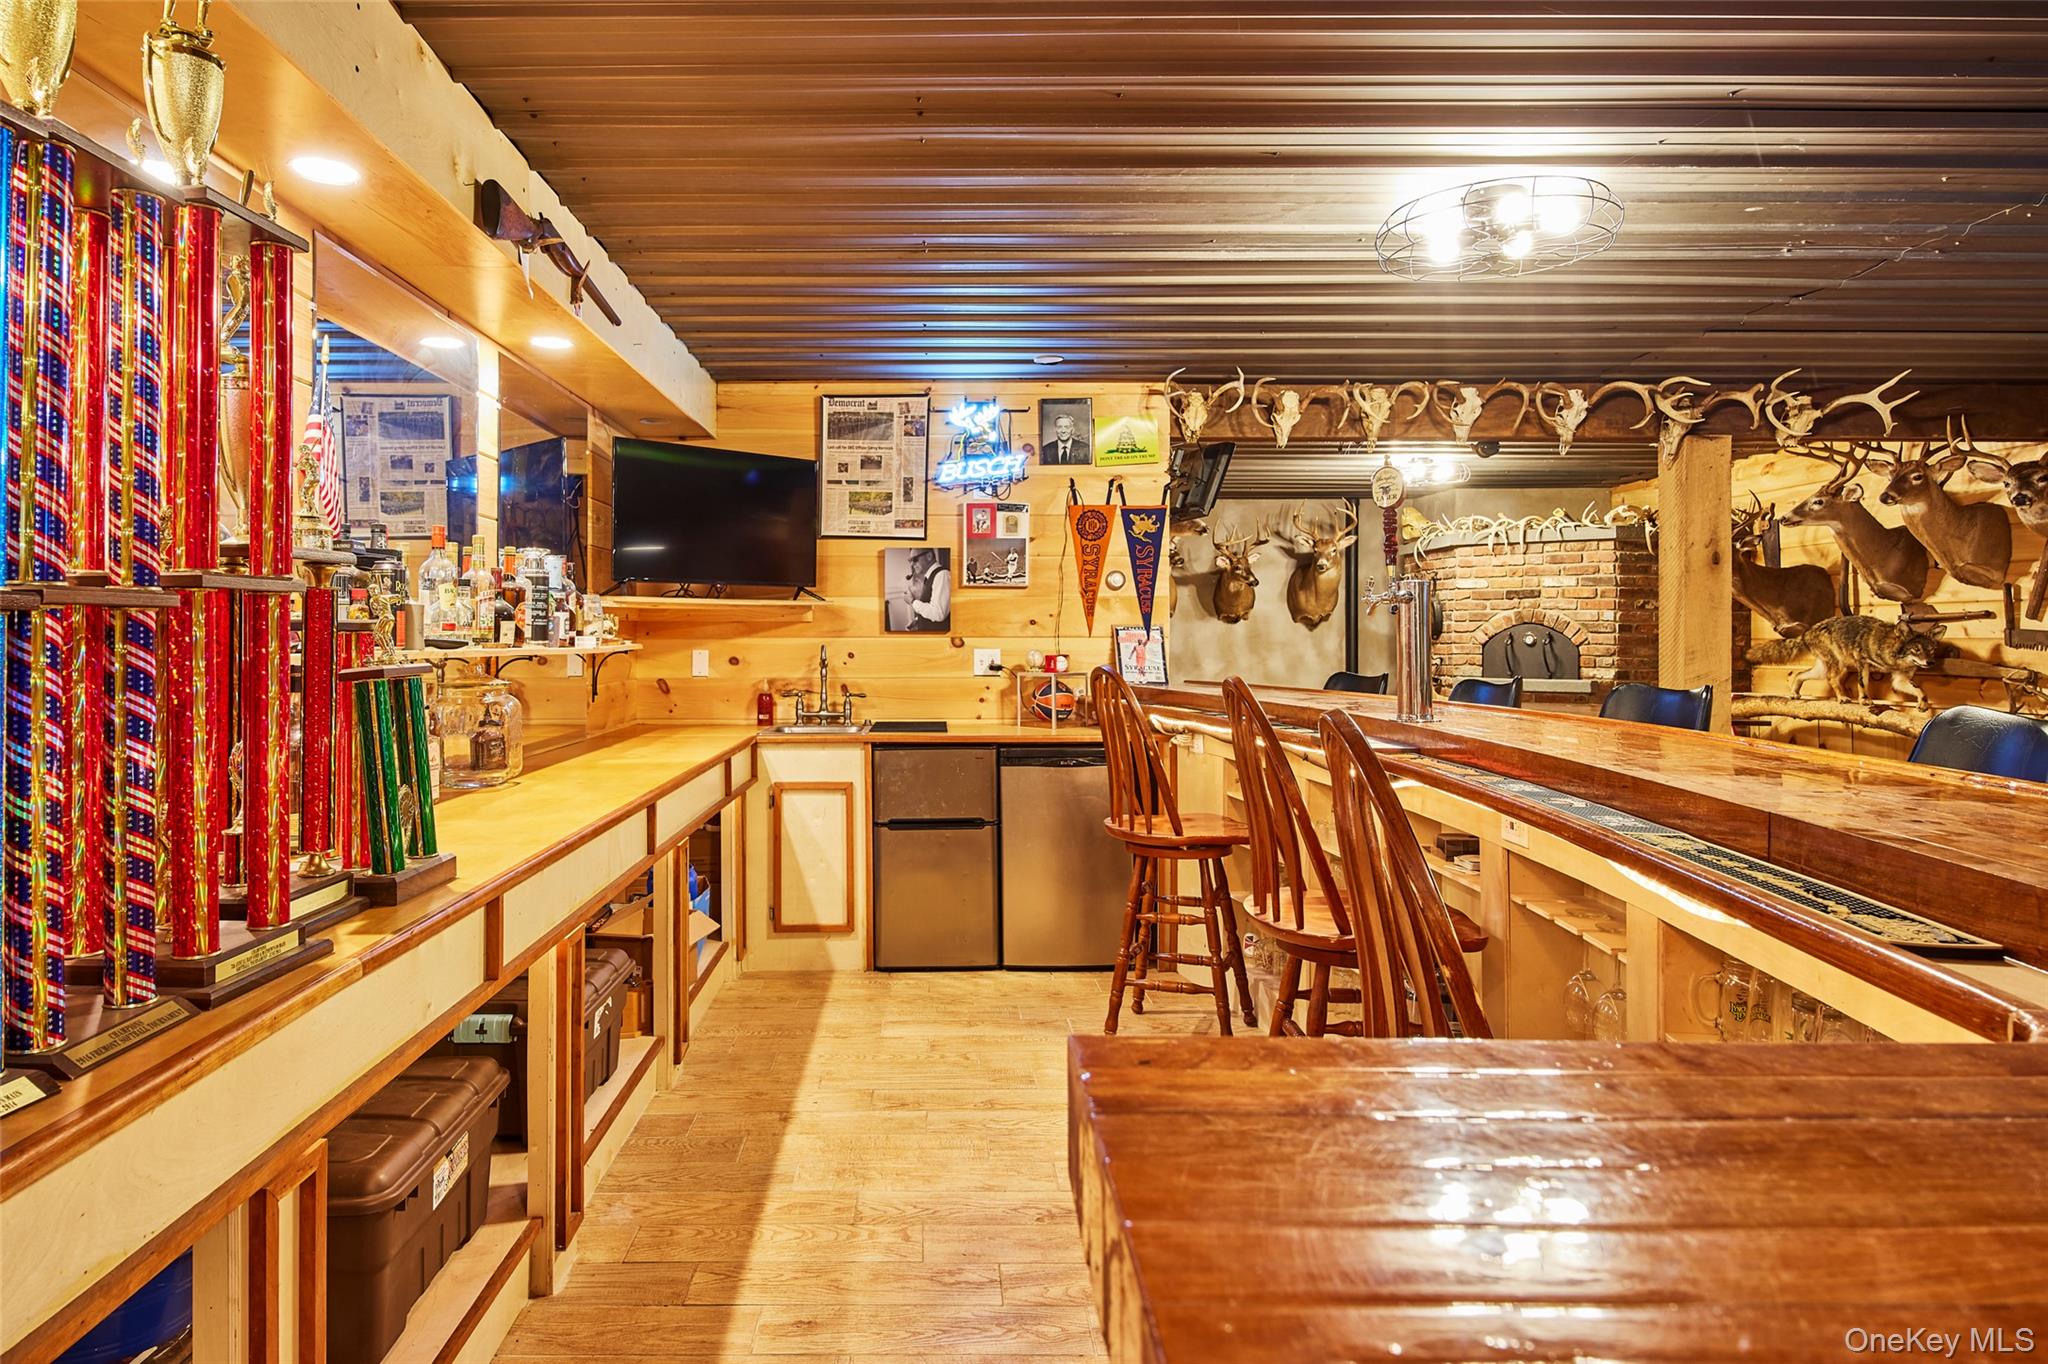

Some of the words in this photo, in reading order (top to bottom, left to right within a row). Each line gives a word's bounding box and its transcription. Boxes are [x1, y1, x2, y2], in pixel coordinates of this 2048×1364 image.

[937, 454, 1027, 482] BUSCH
[1081, 543, 1101, 617] SYRACUSE
[1135, 544, 1155, 615] SYRACUSE
